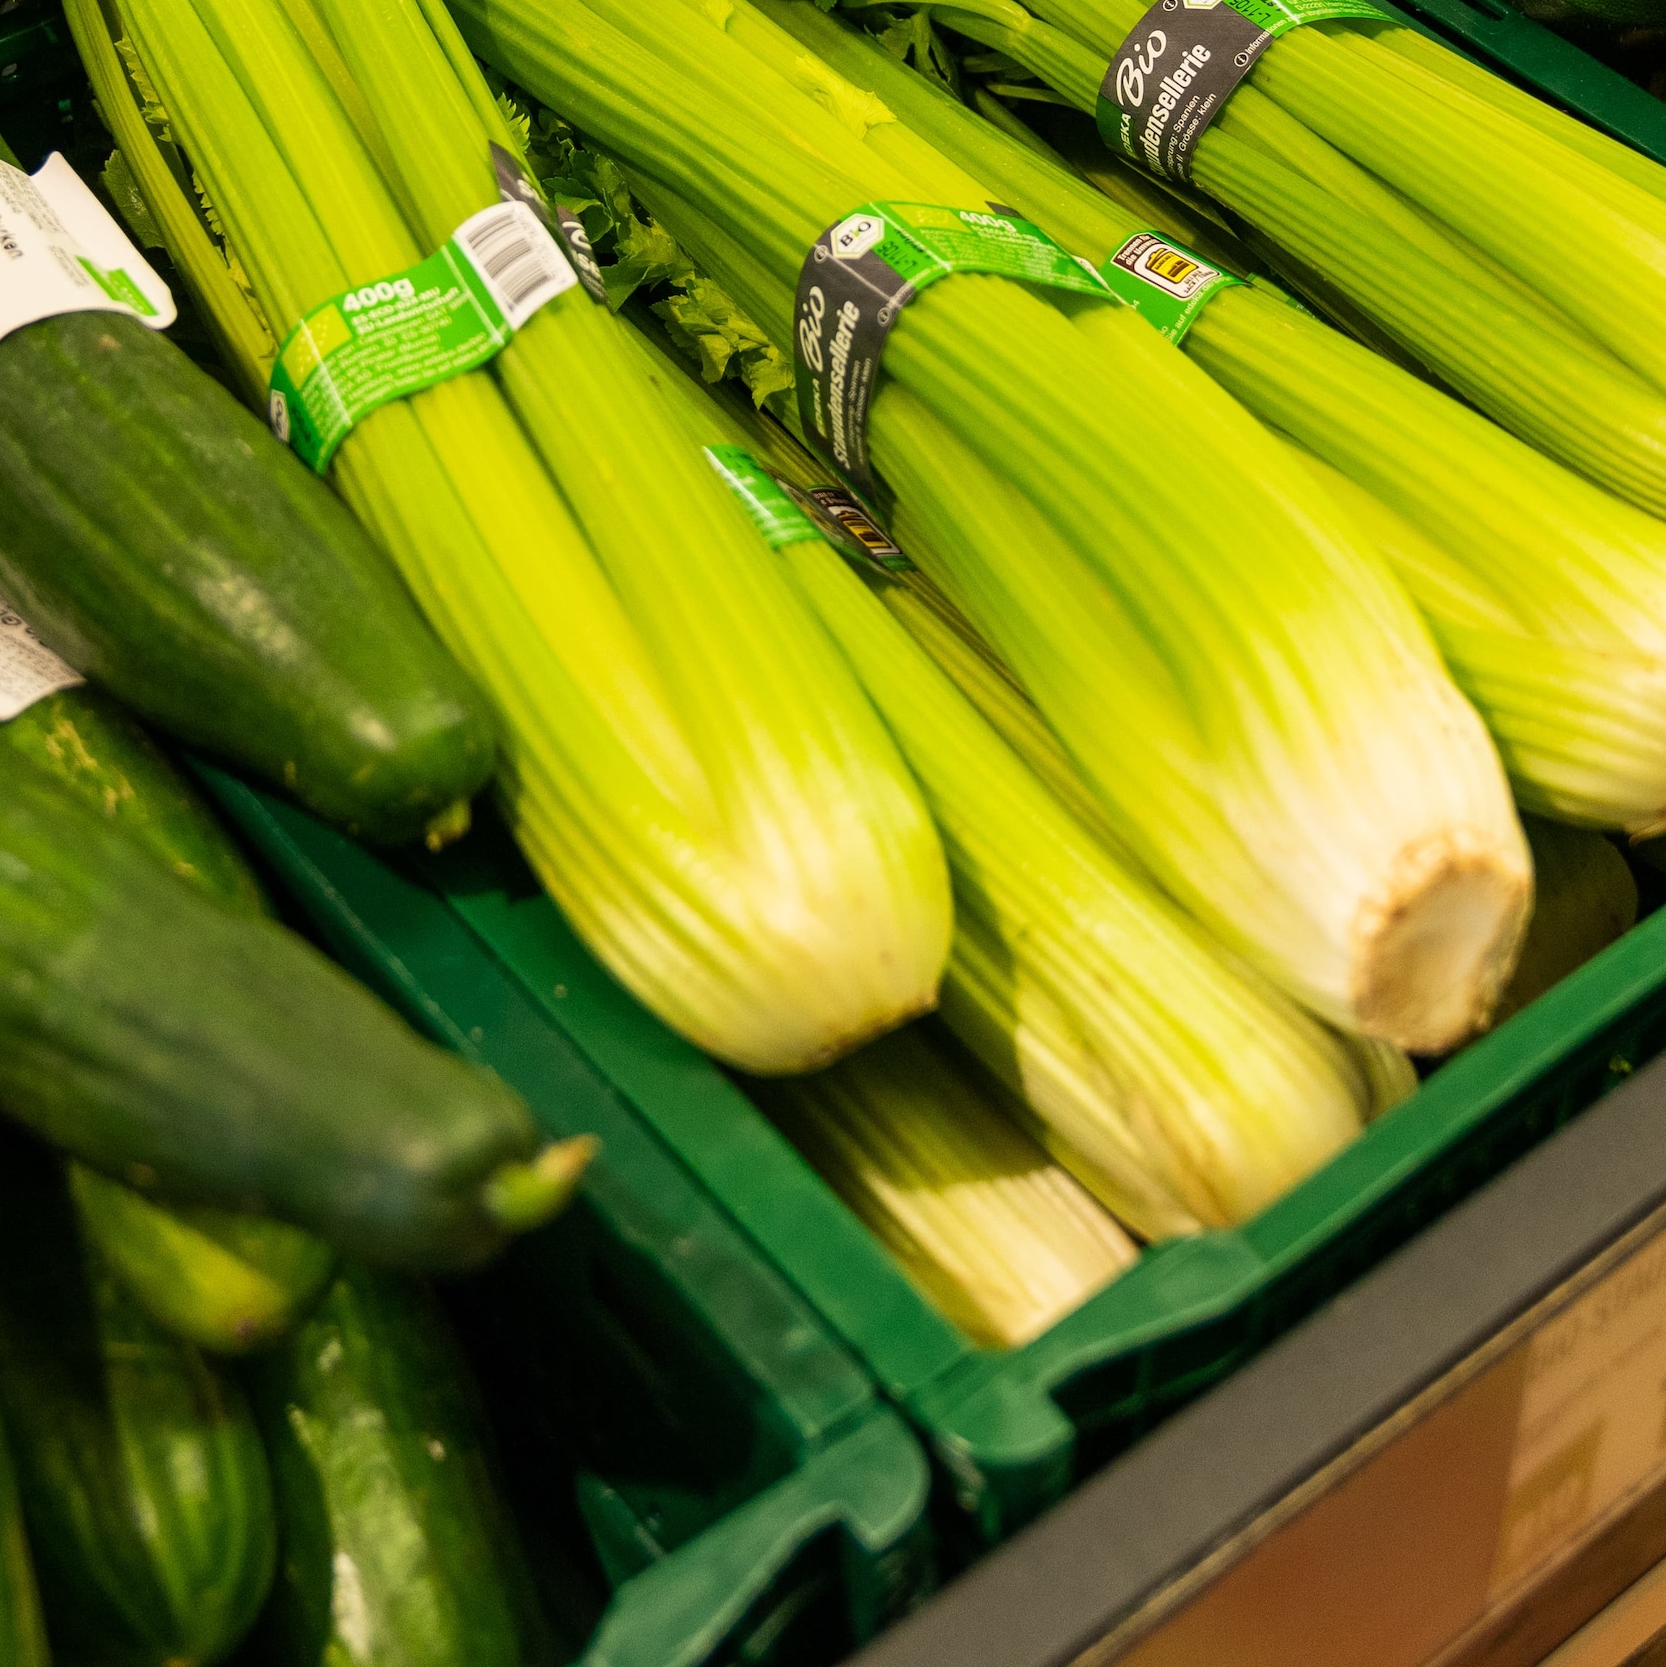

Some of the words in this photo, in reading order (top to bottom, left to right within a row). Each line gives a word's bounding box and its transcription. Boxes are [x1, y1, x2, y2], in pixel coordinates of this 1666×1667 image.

[1115, 29, 1168, 108] Bio
[1172, 94, 1201, 133] Spanien
[1198, 92, 1218, 115] klein
[342, 277, 415, 312] 400g
[798, 284, 826, 373] Bio
[826, 299, 861, 471] Staudensellerie
